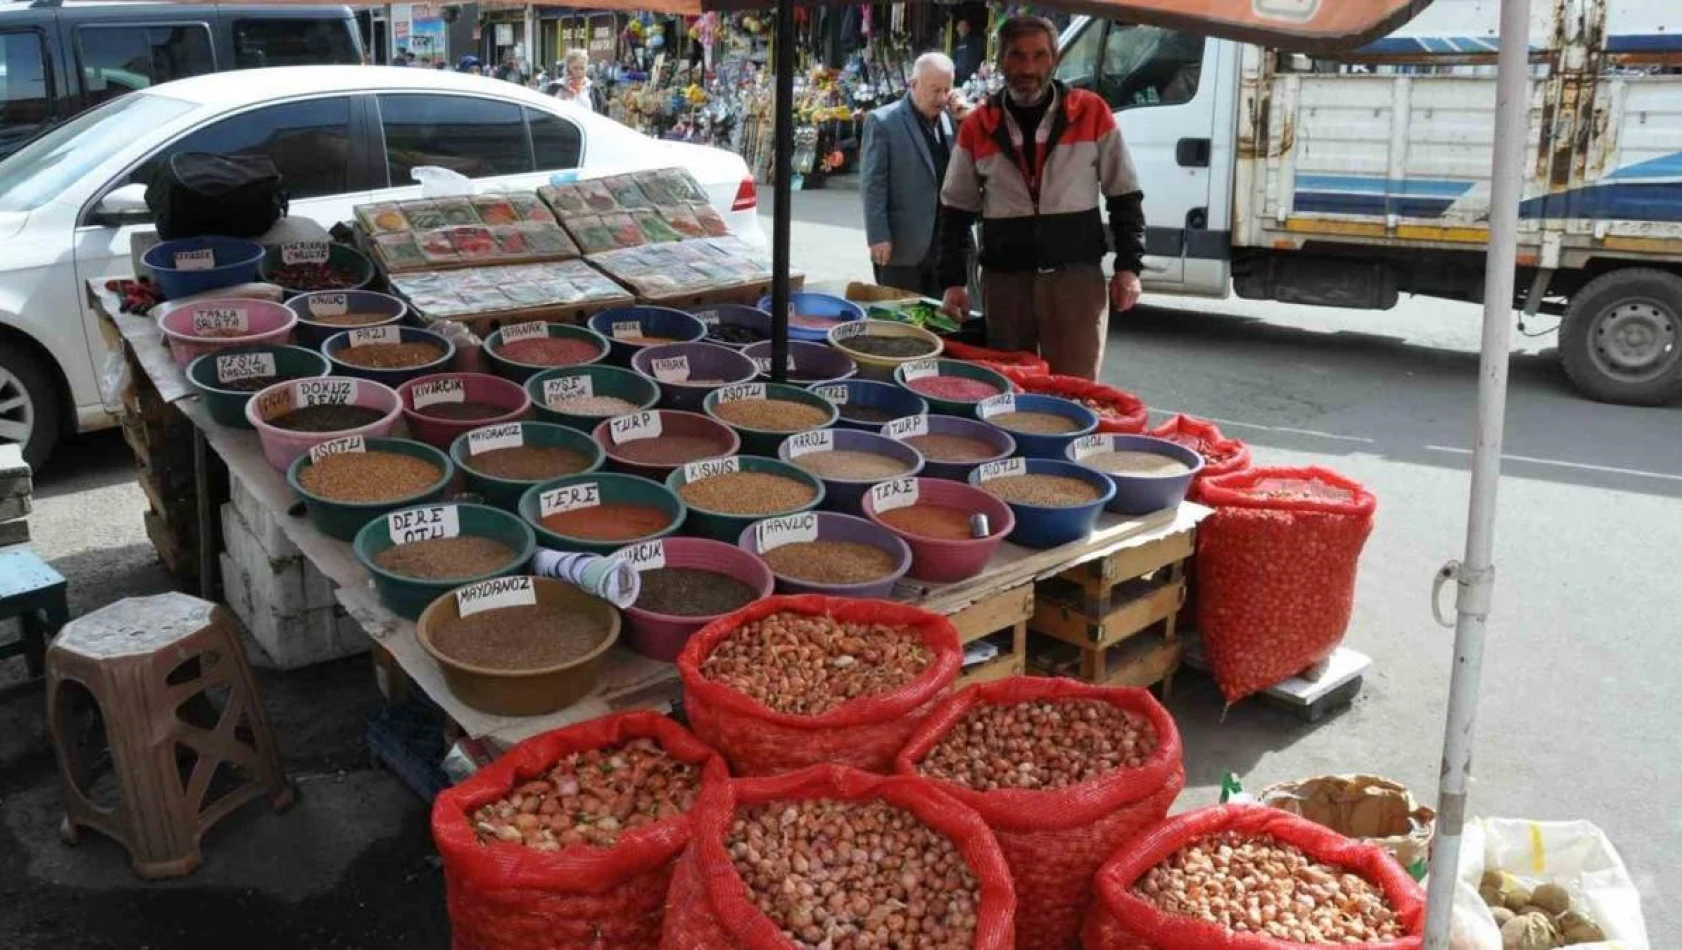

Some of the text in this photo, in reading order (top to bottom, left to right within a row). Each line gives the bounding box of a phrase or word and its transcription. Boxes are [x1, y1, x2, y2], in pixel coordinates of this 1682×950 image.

[300, 382, 352, 396] DOKUZ
[614, 412, 649, 433] TURP
[891, 415, 921, 436] TURP
[542, 486, 597, 510] TERE
[393, 507, 445, 532] DERE
[404, 525, 445, 545] OTU
[459, 577, 530, 604] MAYDANOZ
